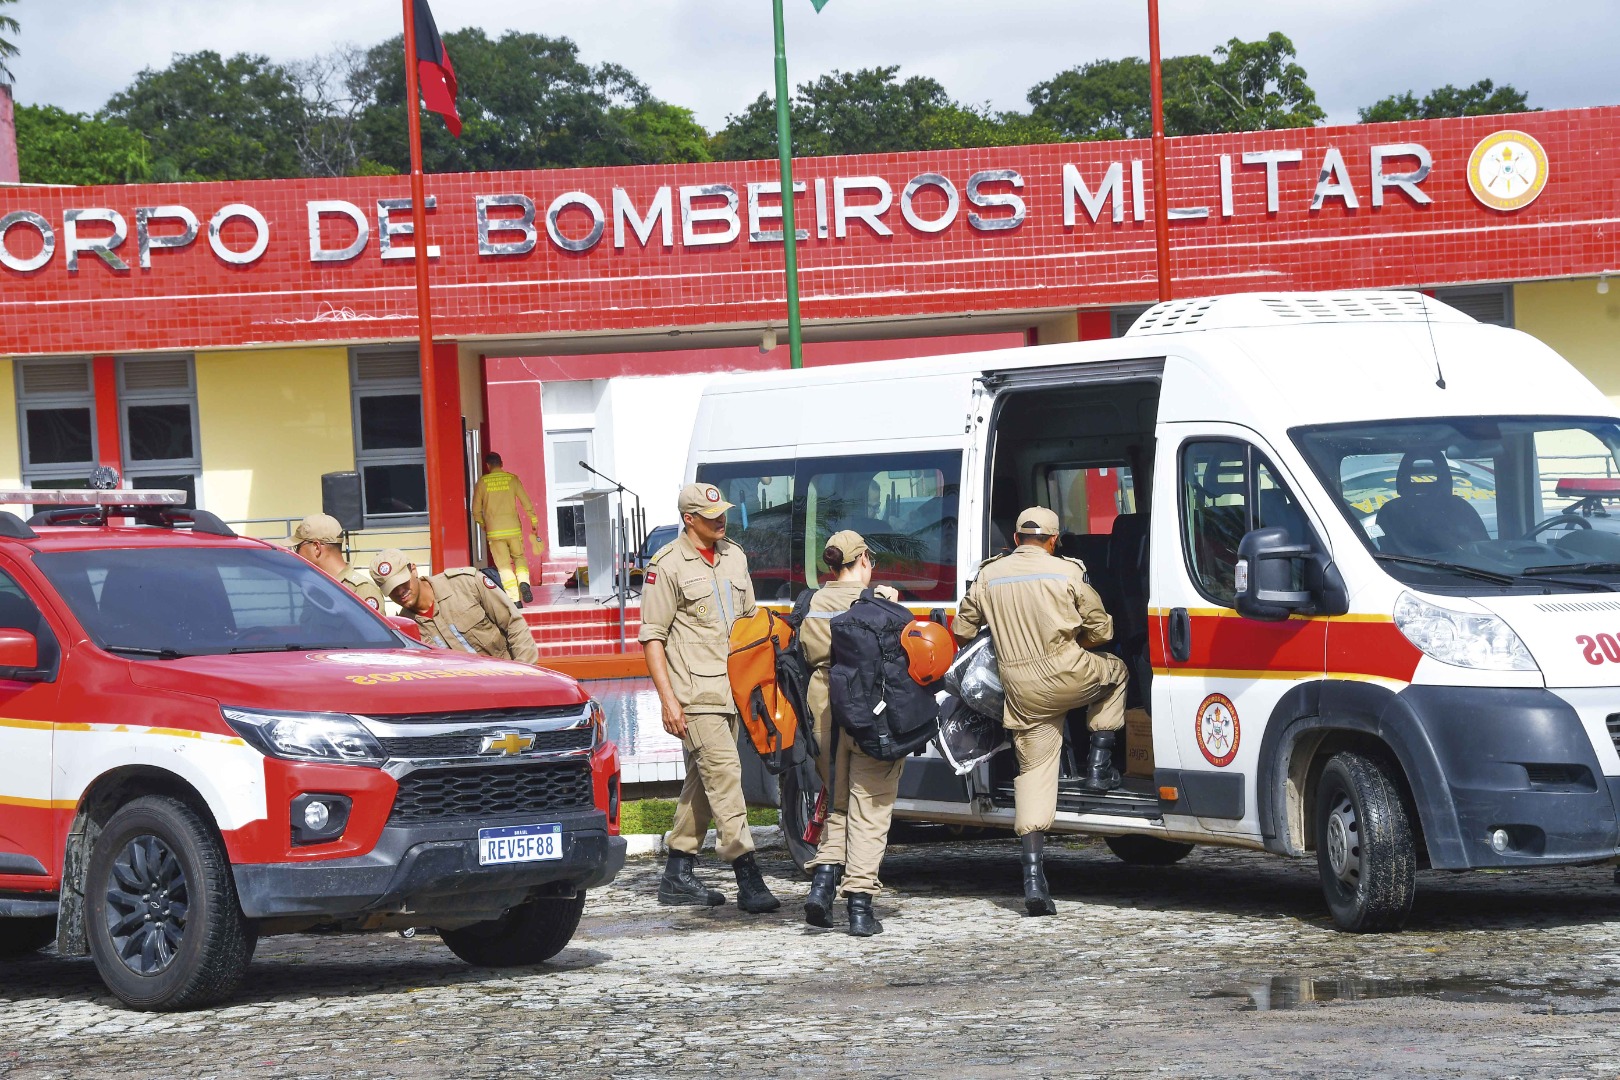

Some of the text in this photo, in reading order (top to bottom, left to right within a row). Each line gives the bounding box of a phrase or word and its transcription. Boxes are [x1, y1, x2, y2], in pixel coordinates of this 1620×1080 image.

[0, 203, 269, 272] ORPO
[307, 194, 440, 262] DE
[476, 169, 1026, 255] BOMBEIROS
[488, 836, 554, 860] REV5F88
